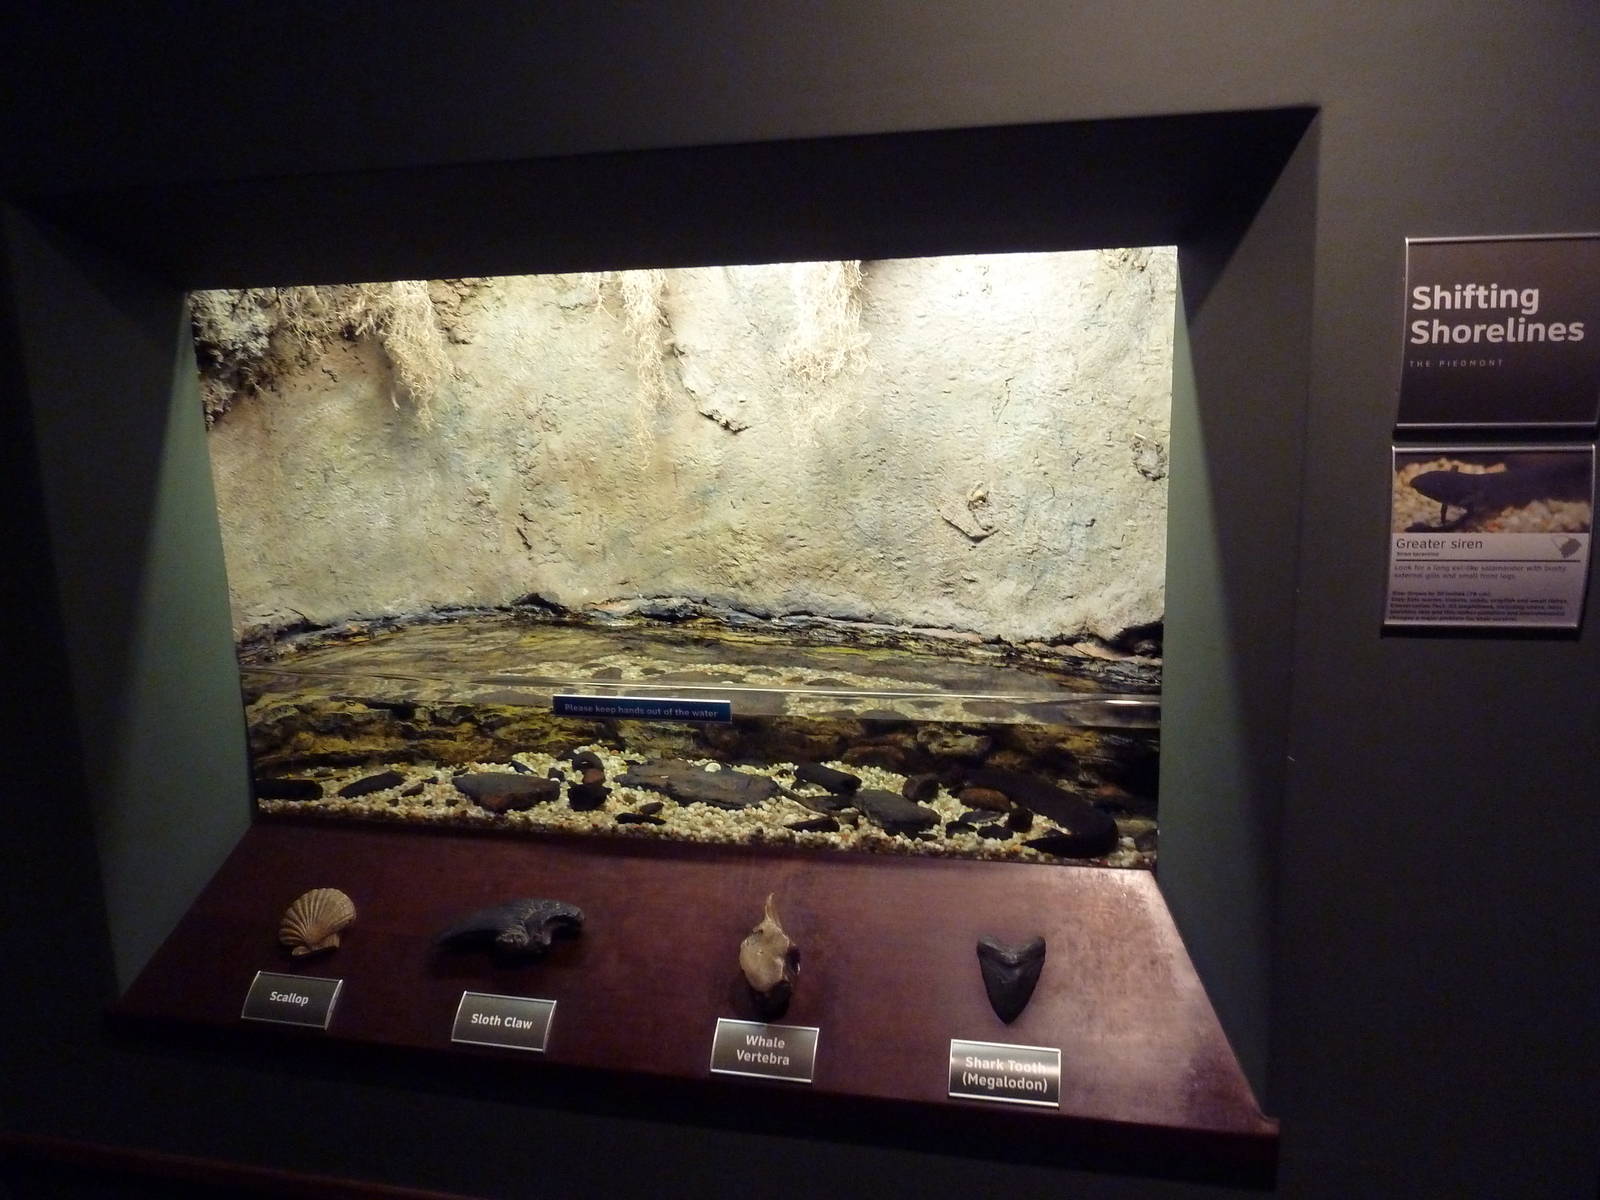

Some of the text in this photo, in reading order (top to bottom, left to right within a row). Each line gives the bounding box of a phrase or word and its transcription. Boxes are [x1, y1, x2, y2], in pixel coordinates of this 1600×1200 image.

[1412, 283, 1539, 315] Shifting
[1410, 317, 1585, 344] Shorelines
[1410, 359, 1504, 368] THE PIEDMONT
[1396, 538, 1483, 549] Greater siren
[564, 703, 719, 718] Please keep hands out of the water
[269, 990, 309, 1007] Scallop
[471, 1013, 533, 1030] Sloth Claw
[745, 1034, 786, 1049] Whale
[736, 1049, 790, 1067] Vertebra
[965, 1056, 1048, 1074] Shark Tooth
[962, 1071, 1048, 1093] (Megalodon)
